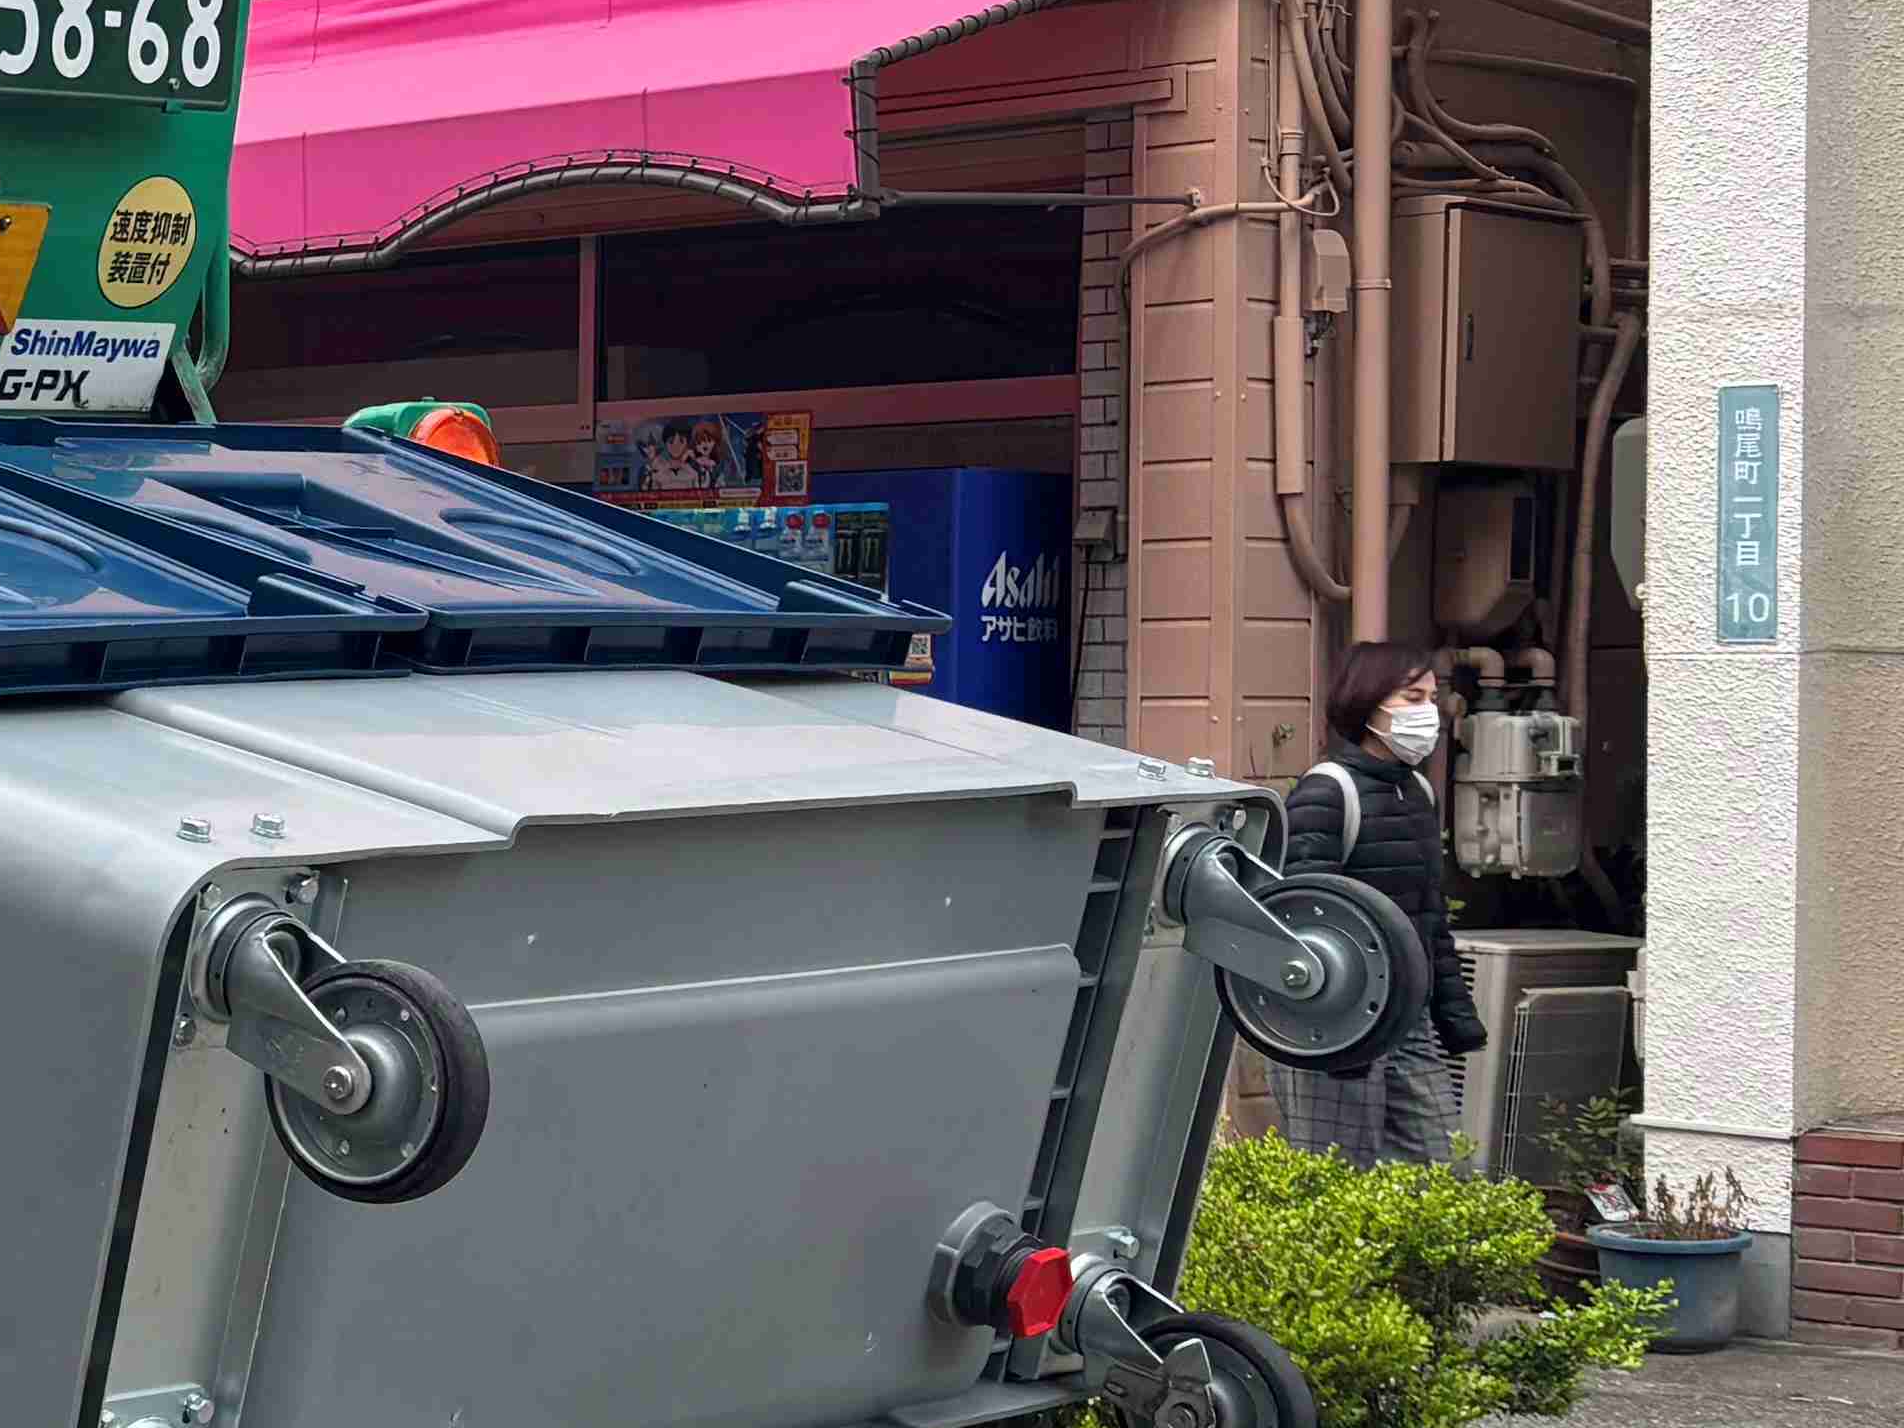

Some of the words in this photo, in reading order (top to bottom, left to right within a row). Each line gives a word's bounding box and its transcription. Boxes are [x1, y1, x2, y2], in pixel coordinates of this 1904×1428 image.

[110, 210, 192, 245] 速度抑制
[106, 251, 172, 285] 装置付
[10, 327, 161, 363] ShinMaywa
[981, 549, 1060, 609] Asahi
[1725, 591, 1771, 623] 10
[980, 615, 1059, 643] アサヒ飲料
